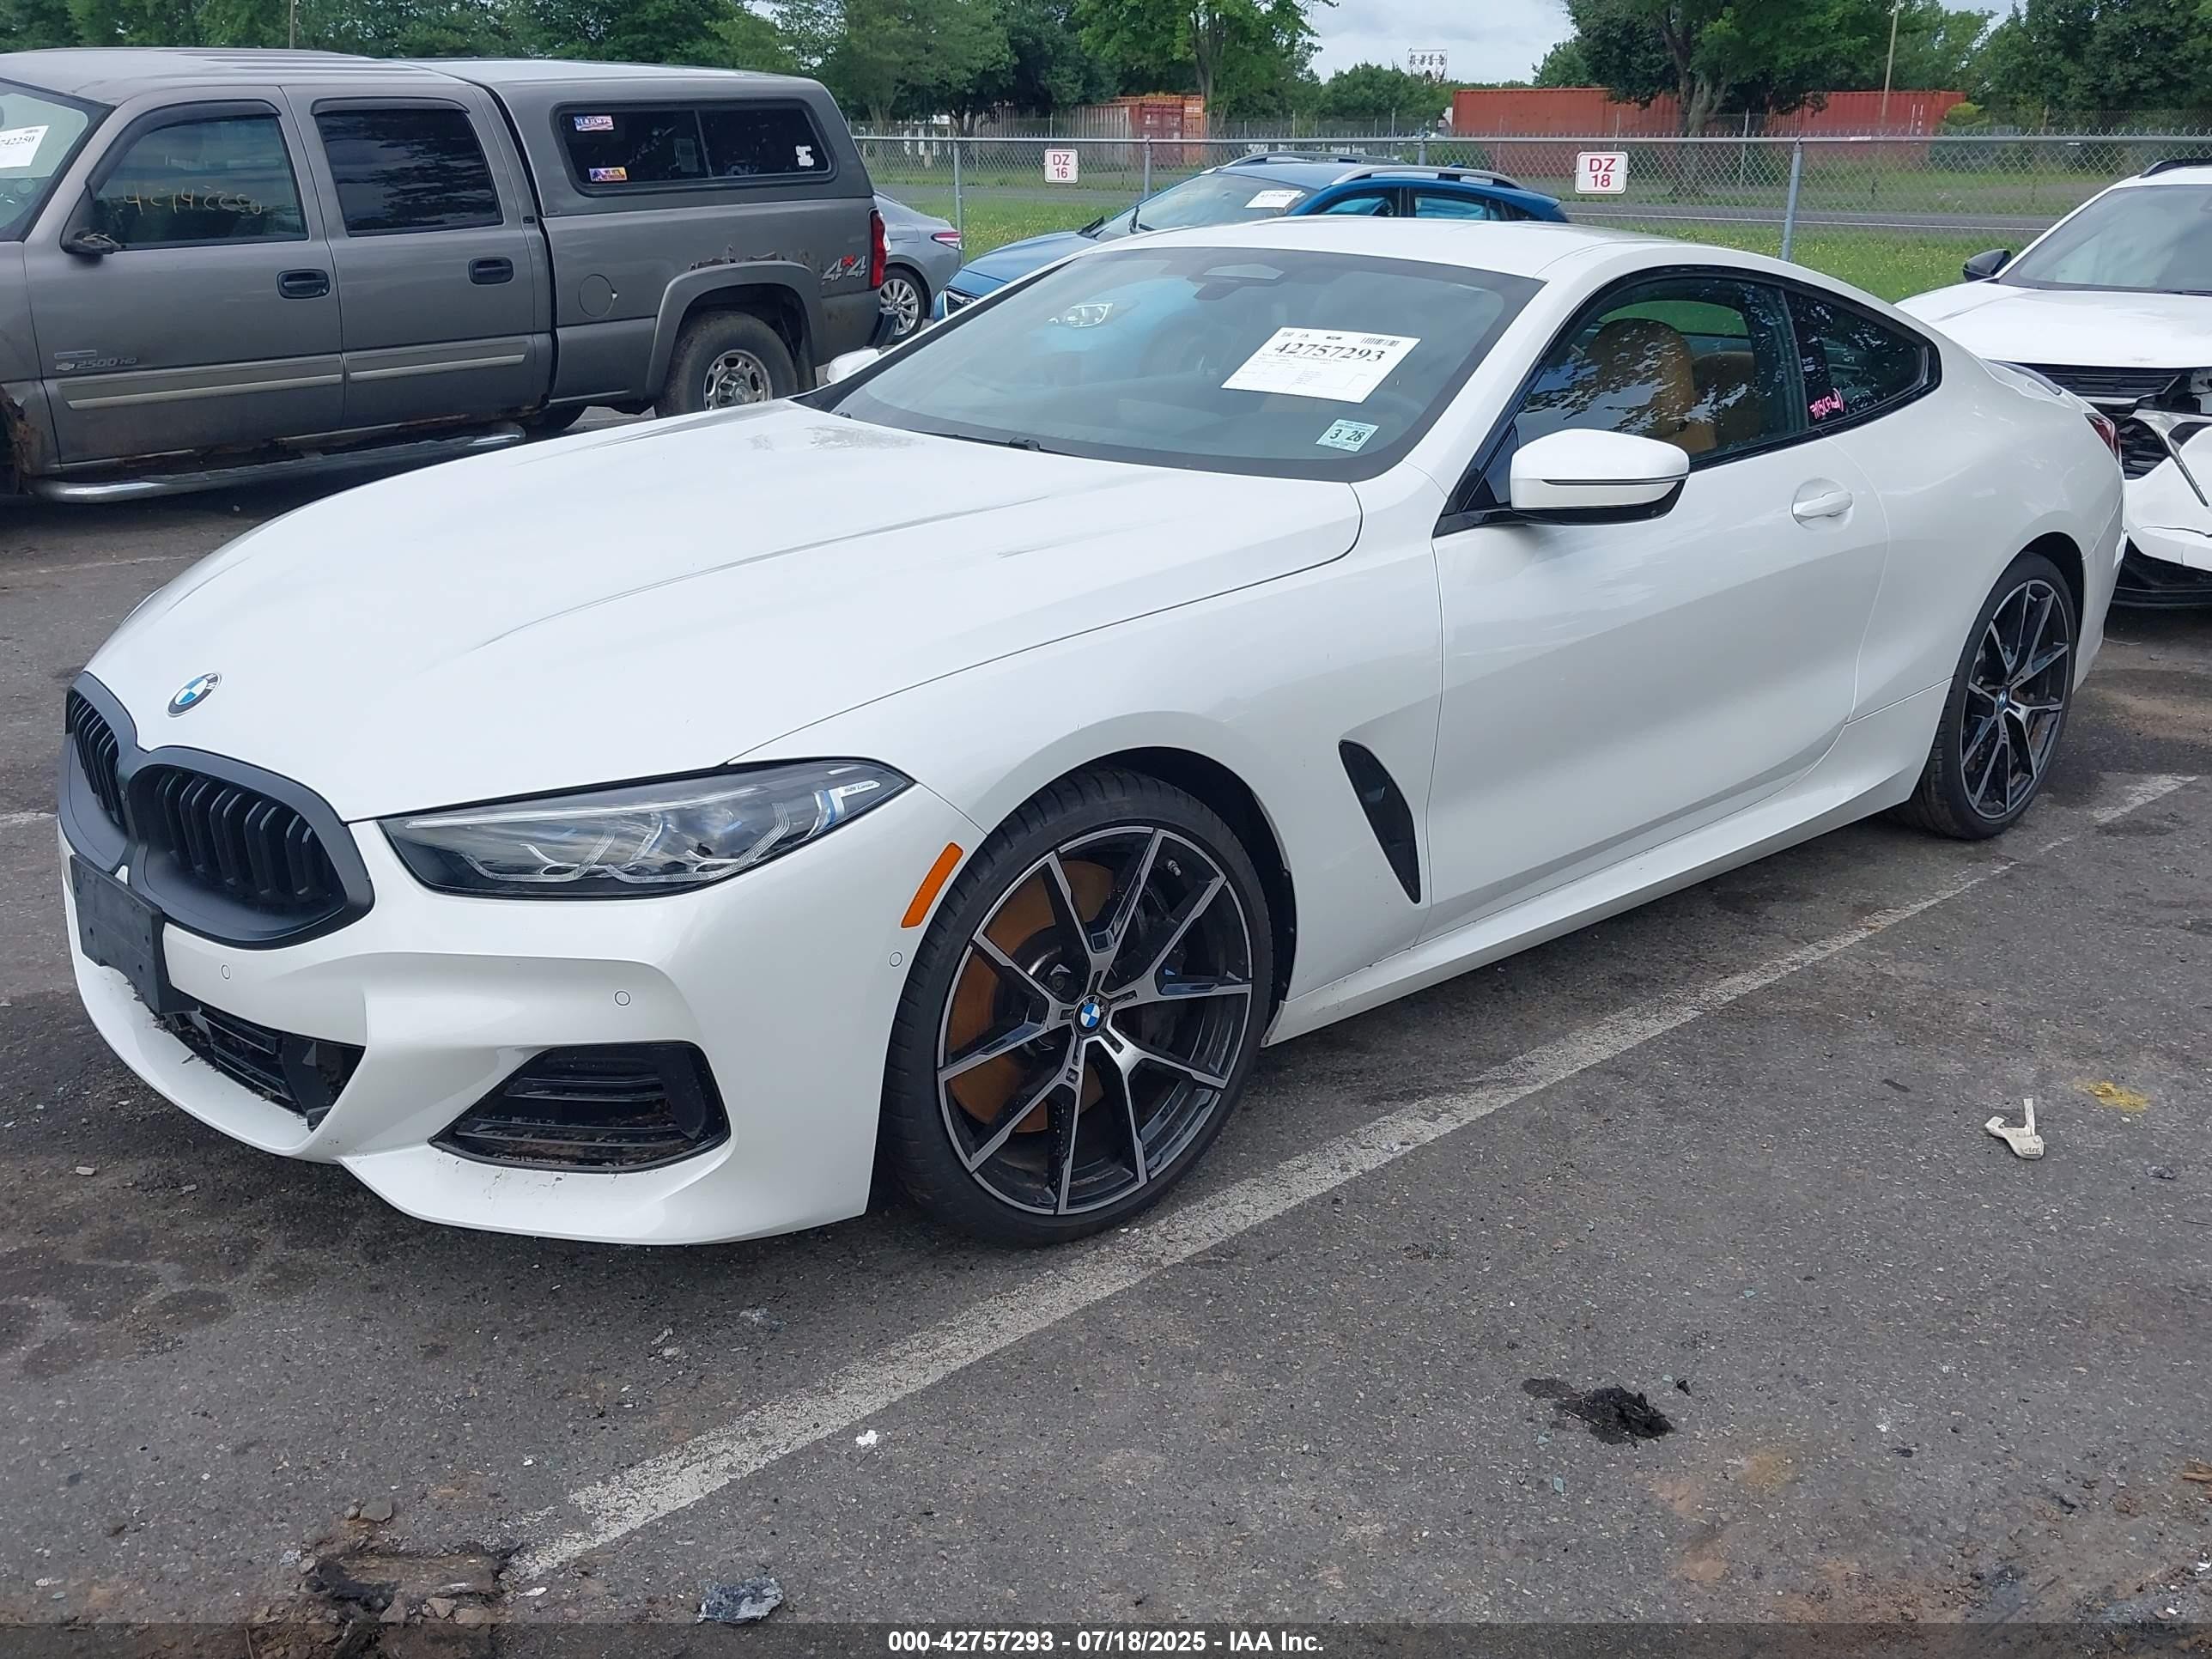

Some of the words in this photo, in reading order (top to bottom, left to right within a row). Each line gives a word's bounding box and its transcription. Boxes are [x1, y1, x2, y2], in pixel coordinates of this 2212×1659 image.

[1053, 154, 1070, 166] DZ
[1589, 158, 1616, 172] DZ
[1055, 167, 1068, 179] 16
[1591, 173, 1611, 187] 18
[1274, 342, 1386, 362] 42757293
[76, 358, 118, 369] 2500
[1329, 428, 1343, 439] 3
[1345, 430, 1366, 442] 28
